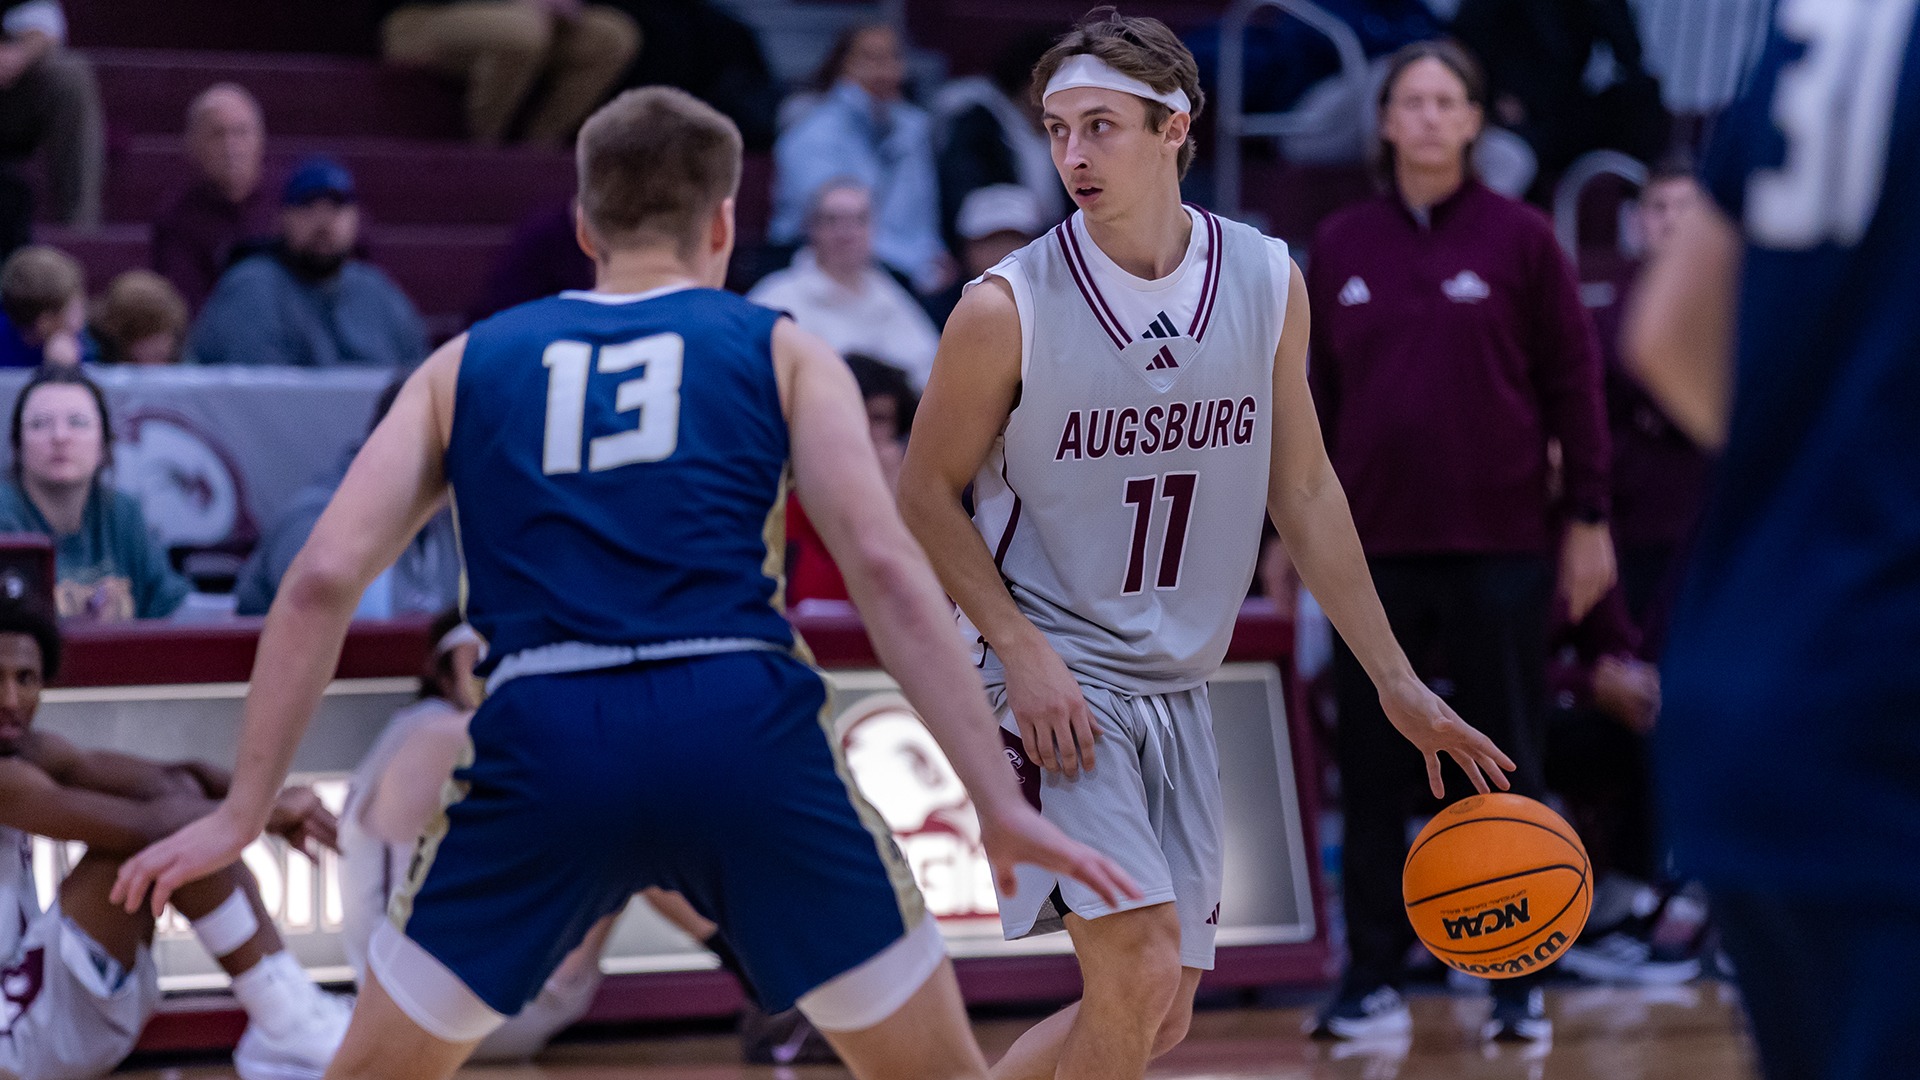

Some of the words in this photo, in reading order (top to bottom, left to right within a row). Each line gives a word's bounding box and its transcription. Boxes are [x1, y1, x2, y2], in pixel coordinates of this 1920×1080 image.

[541, 331, 685, 476] 13
[1053, 396, 1257, 462] AUGSBURG
[1120, 470, 1200, 596] 11
[1441, 897, 1531, 940] NCAA
[1446, 930, 1570, 974] Wilson
